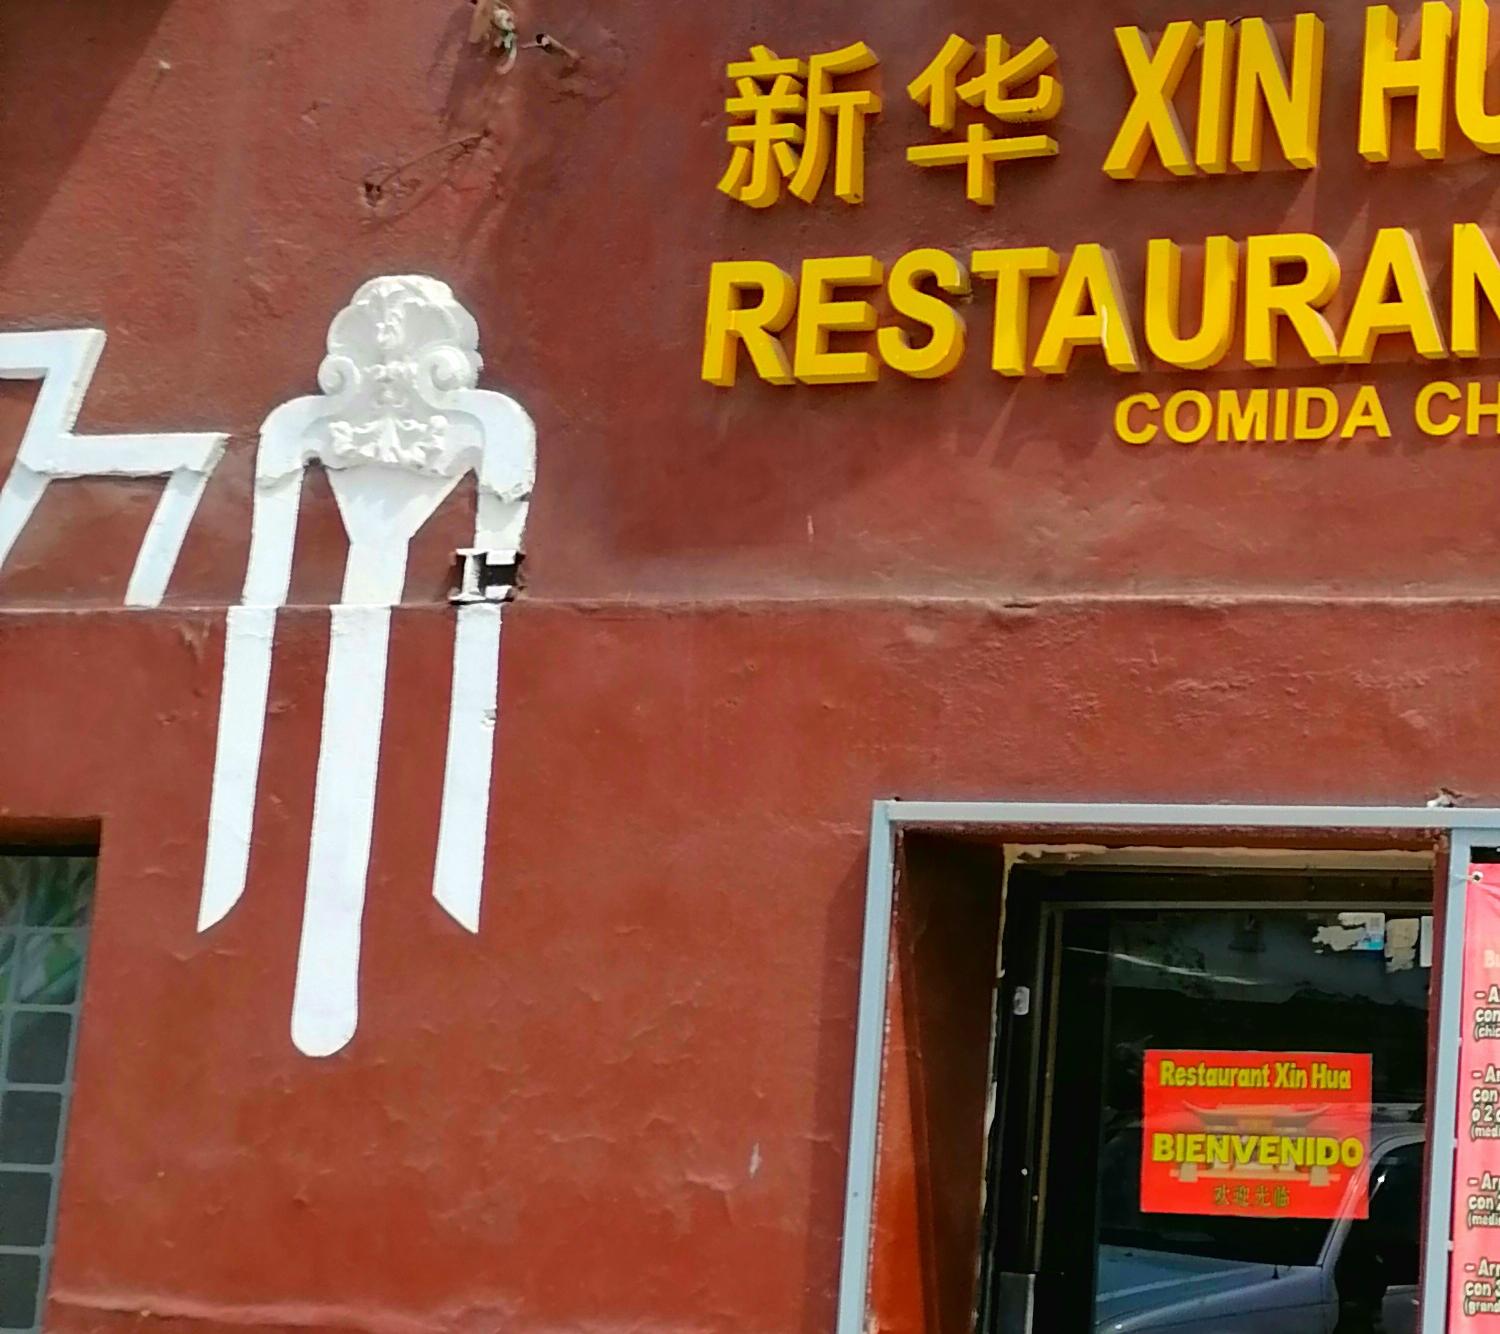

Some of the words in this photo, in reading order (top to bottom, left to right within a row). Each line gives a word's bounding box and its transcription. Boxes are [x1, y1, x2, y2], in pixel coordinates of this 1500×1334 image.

[718, 33, 1063, 207] 新华
[1103, 13, 1325, 180] XIN
[1114, 385, 1391, 444] COMIDA
[1475, 1009, 1500, 1023] con
[1159, 1060, 1270, 1088] Restaurant
[1274, 1062, 1307, 1089] Xin
[1311, 1063, 1351, 1090] Hua
[1472, 1088, 1498, 1102] con
[1153, 1132, 1364, 1167] BIENVENIDO
[1469, 1196, 1494, 1210] con
[1465, 1282, 1491, 1296] con
